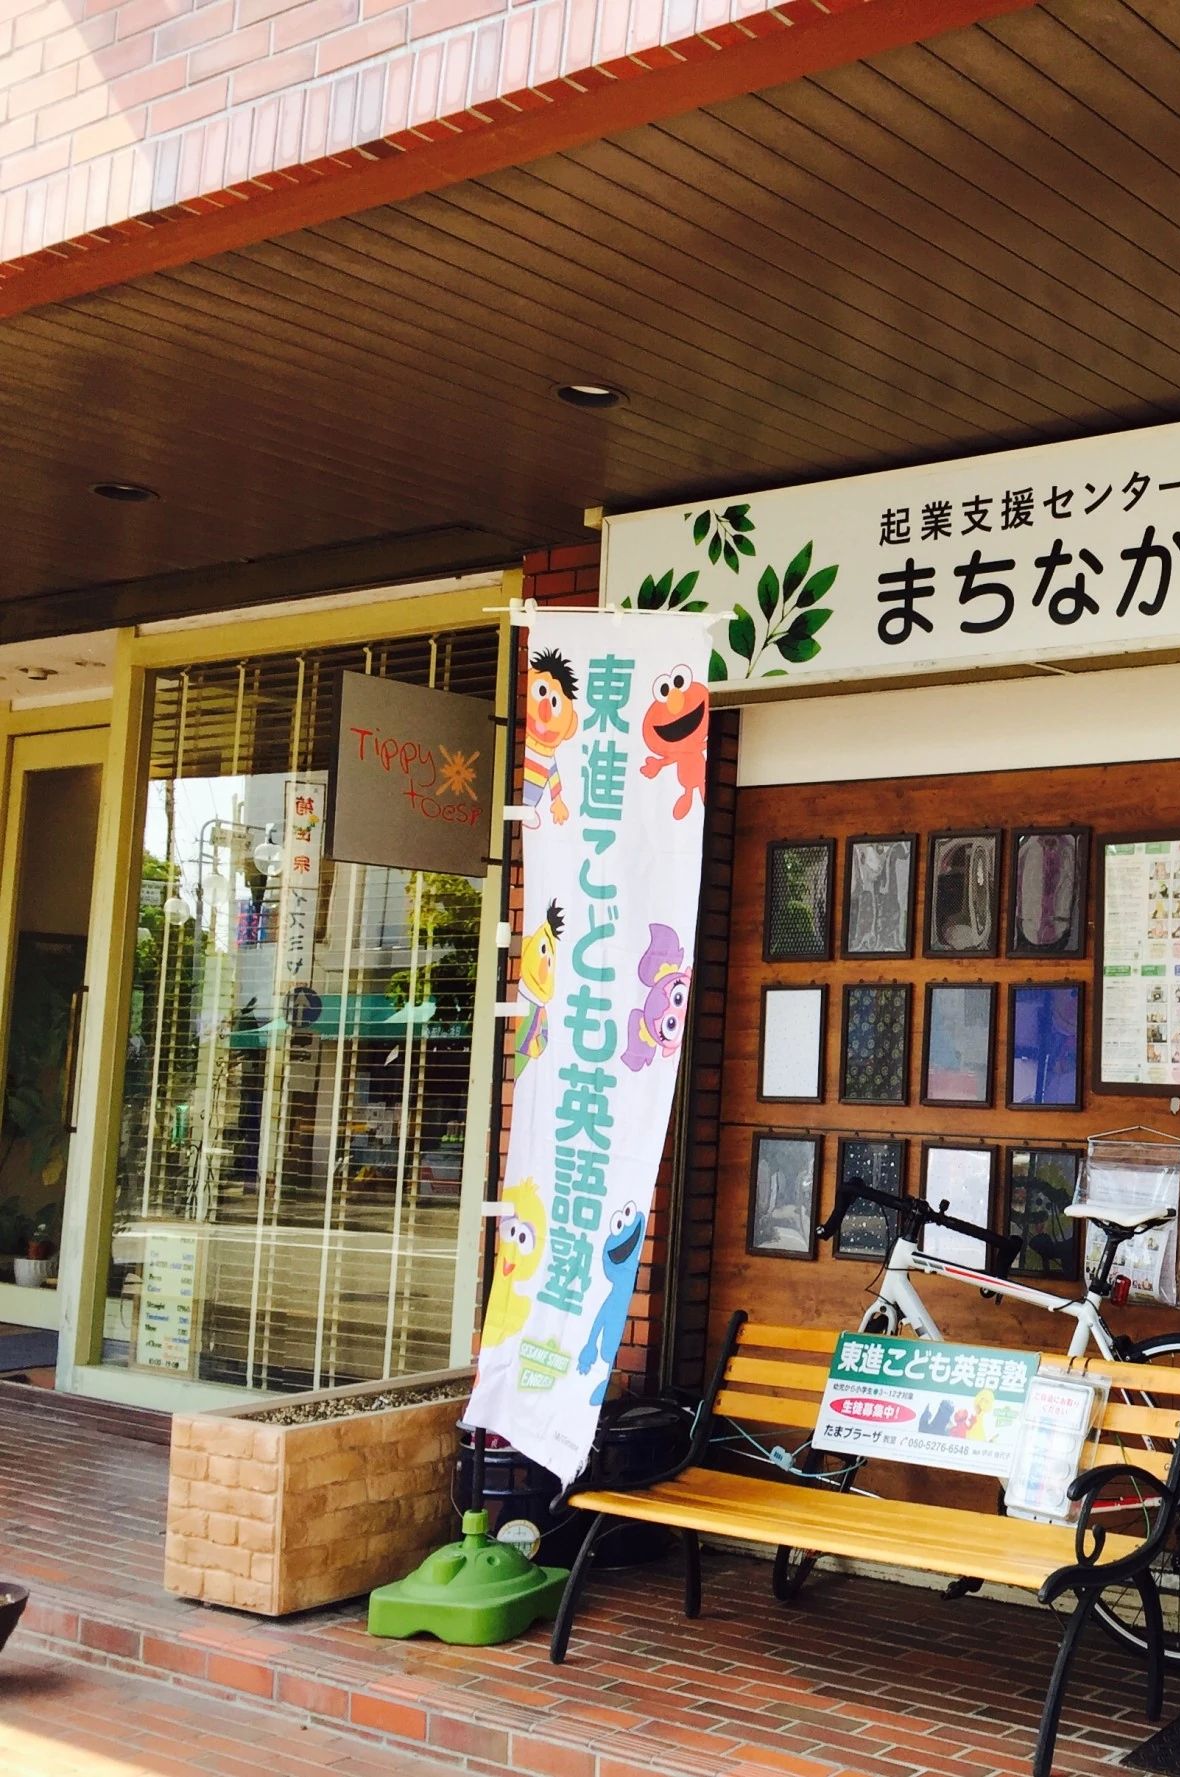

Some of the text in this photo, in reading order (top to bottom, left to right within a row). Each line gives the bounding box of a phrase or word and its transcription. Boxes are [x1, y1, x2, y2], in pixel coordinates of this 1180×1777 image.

[350, 726, 437, 788] Tippy
[535, 653, 635, 1317] 東進こども英語塾
[839, 1340, 1028, 1395] 東進こども英語塾
[823, 1424, 882, 1444] たまプラーザ
